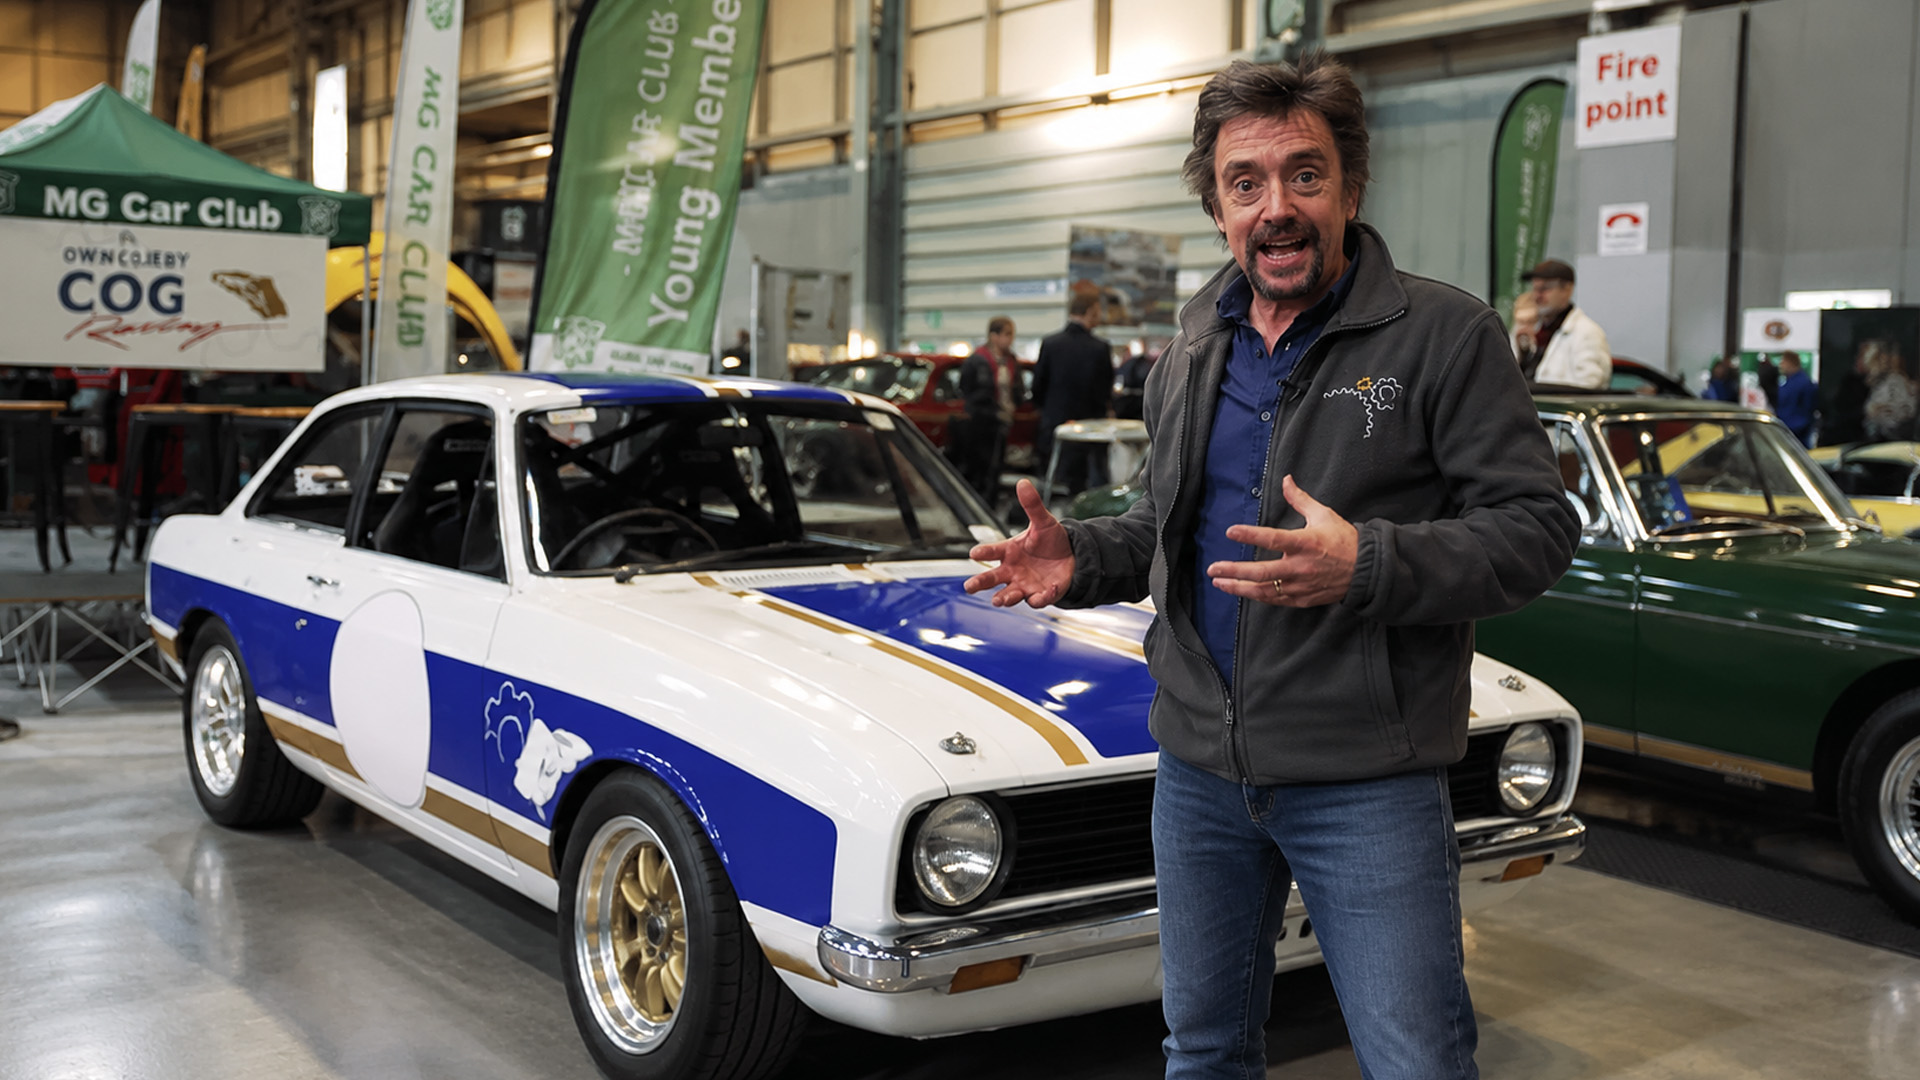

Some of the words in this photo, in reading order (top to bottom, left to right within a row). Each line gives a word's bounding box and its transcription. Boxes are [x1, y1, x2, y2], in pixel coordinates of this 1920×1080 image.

[1597, 50, 1659, 82] Fire
[416, 65, 443, 130] MG
[1585, 89, 1668, 129] point
[43, 185, 110, 220] MG
[119, 191, 191, 224] Car
[197, 196, 283, 231] Club
[647, 184, 722, 328] Young
[58, 269, 185, 317] COG
